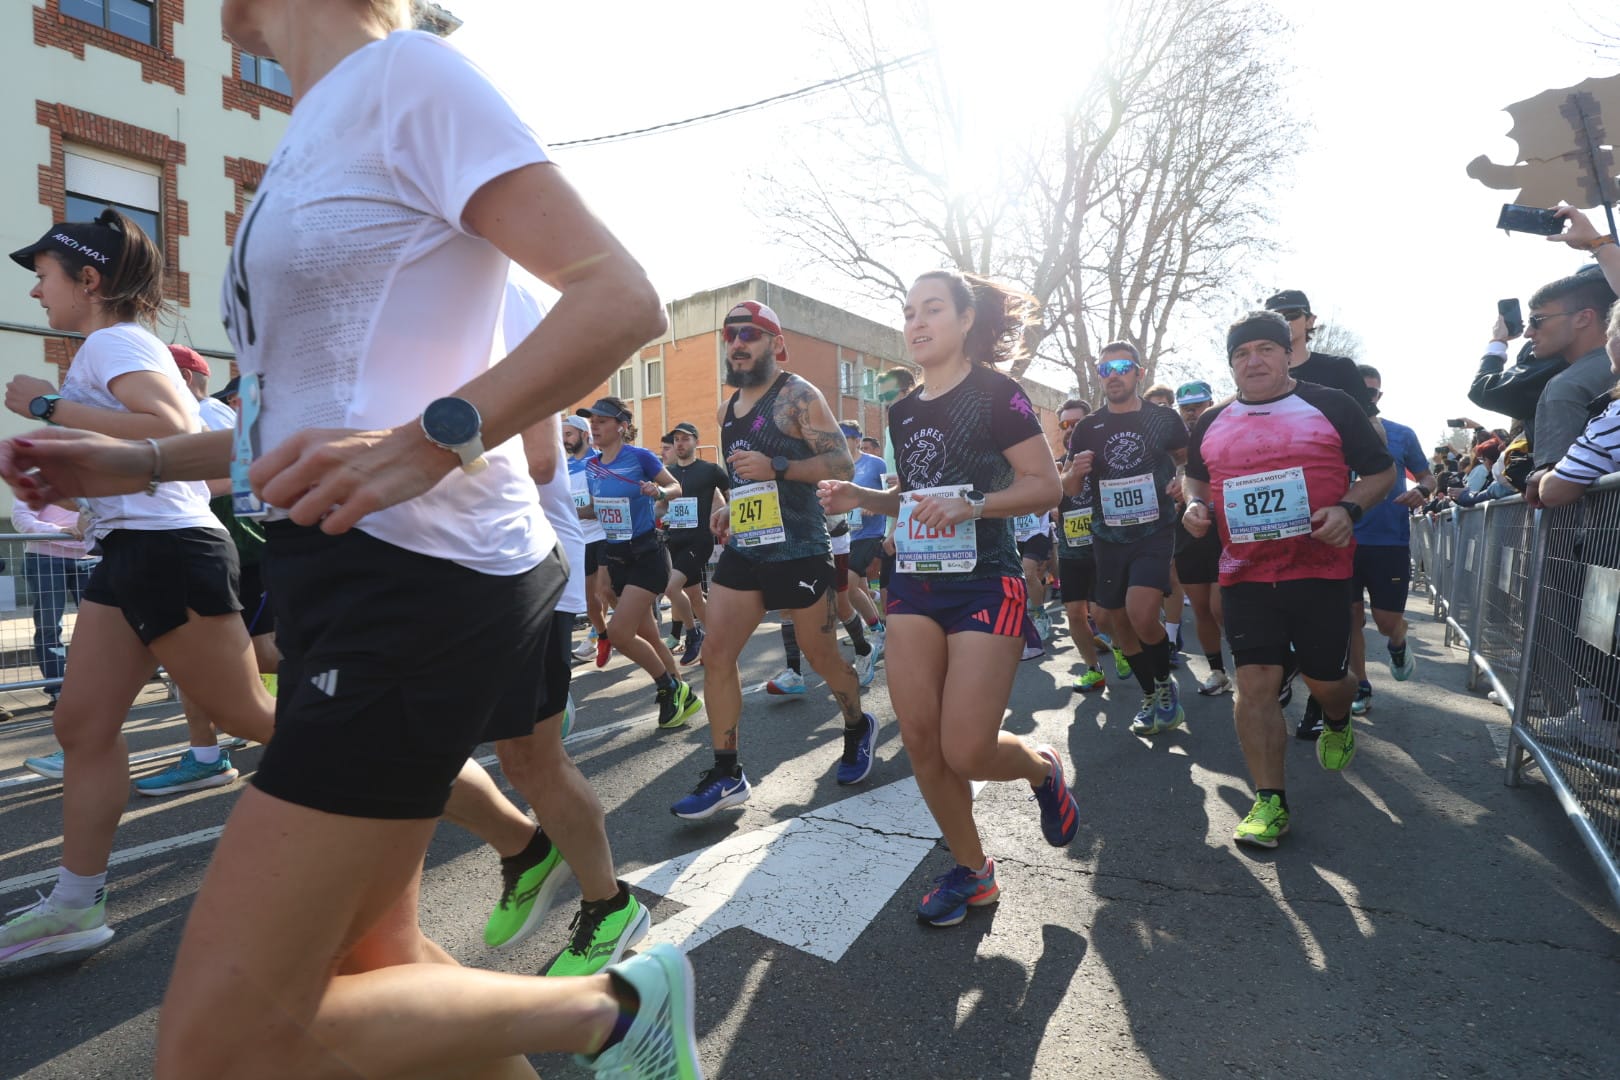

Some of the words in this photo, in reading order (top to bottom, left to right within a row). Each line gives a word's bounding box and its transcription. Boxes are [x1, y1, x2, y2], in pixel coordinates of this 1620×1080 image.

[78, 245, 110, 264] MAX
[904, 427, 944, 449] LIEBRES
[1107, 431, 1141, 444] LIEBRES
[1130, 458, 1148, 470] CLUB
[910, 479, 925, 489] RUN
[925, 471, 943, 489] CLUB
[1114, 489, 1144, 508] 809
[1243, 488, 1287, 516] 822
[599, 508, 622, 524] 1258
[674, 505, 690, 517] 984
[739, 500, 762, 524] 247
[952, 551, 973, 559] MOTOR
